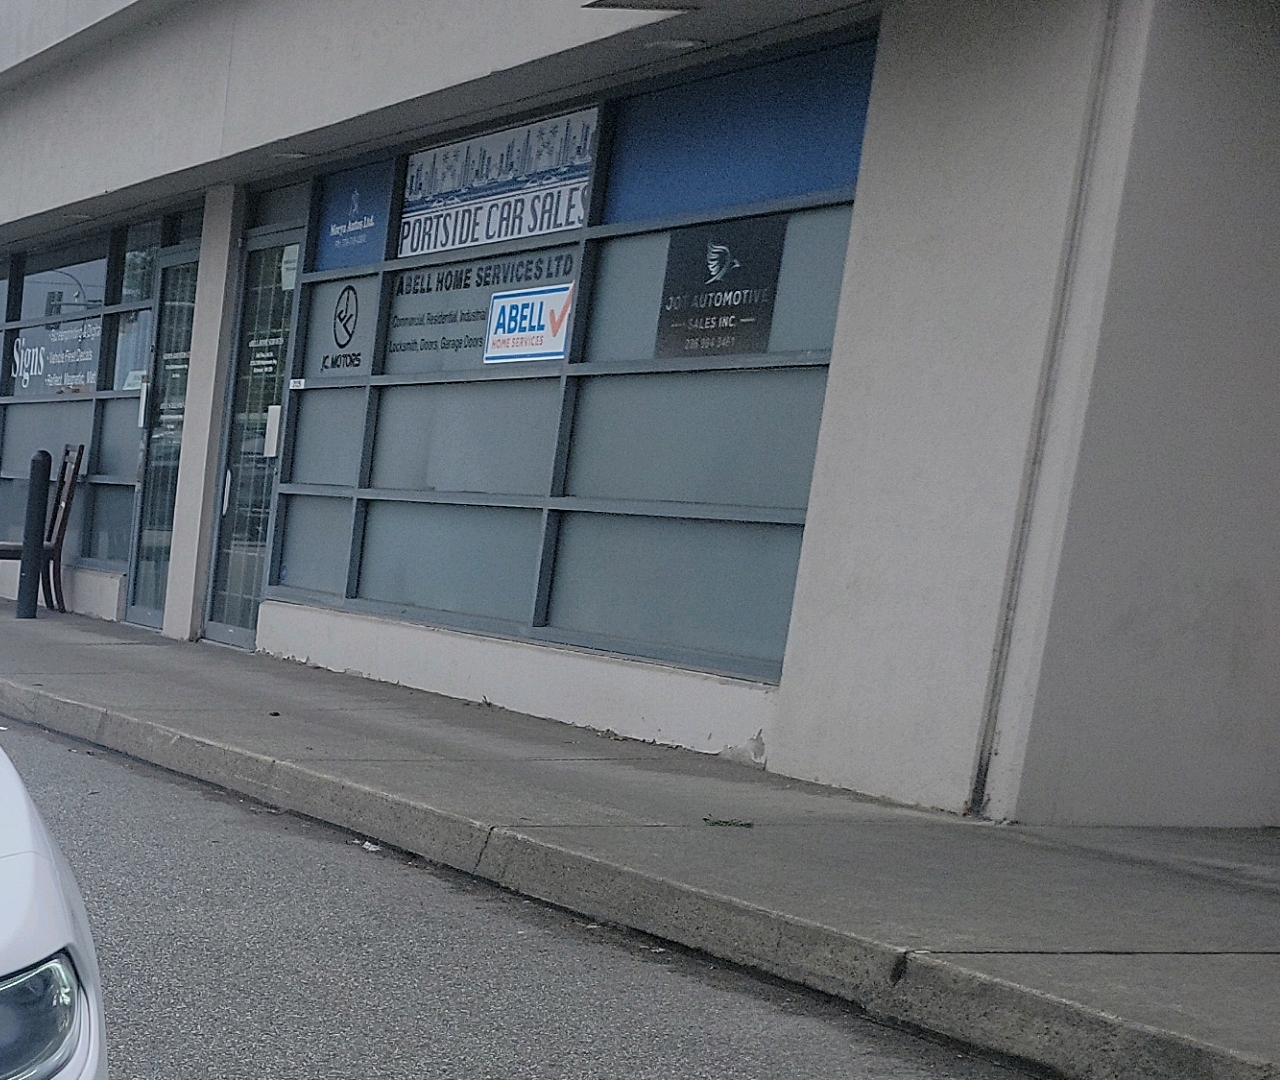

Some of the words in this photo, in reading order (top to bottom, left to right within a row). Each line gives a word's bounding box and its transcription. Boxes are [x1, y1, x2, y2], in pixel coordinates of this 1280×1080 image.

[399, 206, 483, 255] PORTSIDE
[485, 197, 525, 241] CAR
[527, 184, 589, 233] SALES
[396, 273, 432, 297] ABELL
[436, 267, 471, 292] HOME
[475, 256, 545, 287] SERVICES
[545, 253, 574, 280] LTD
[494, 301, 545, 336] ABELL
[331, 352, 361, 369] MOTORS
[492, 337, 511, 349] HOME
[511, 335, 544, 348] SERVICES
[11, 337, 45, 388] Signs
